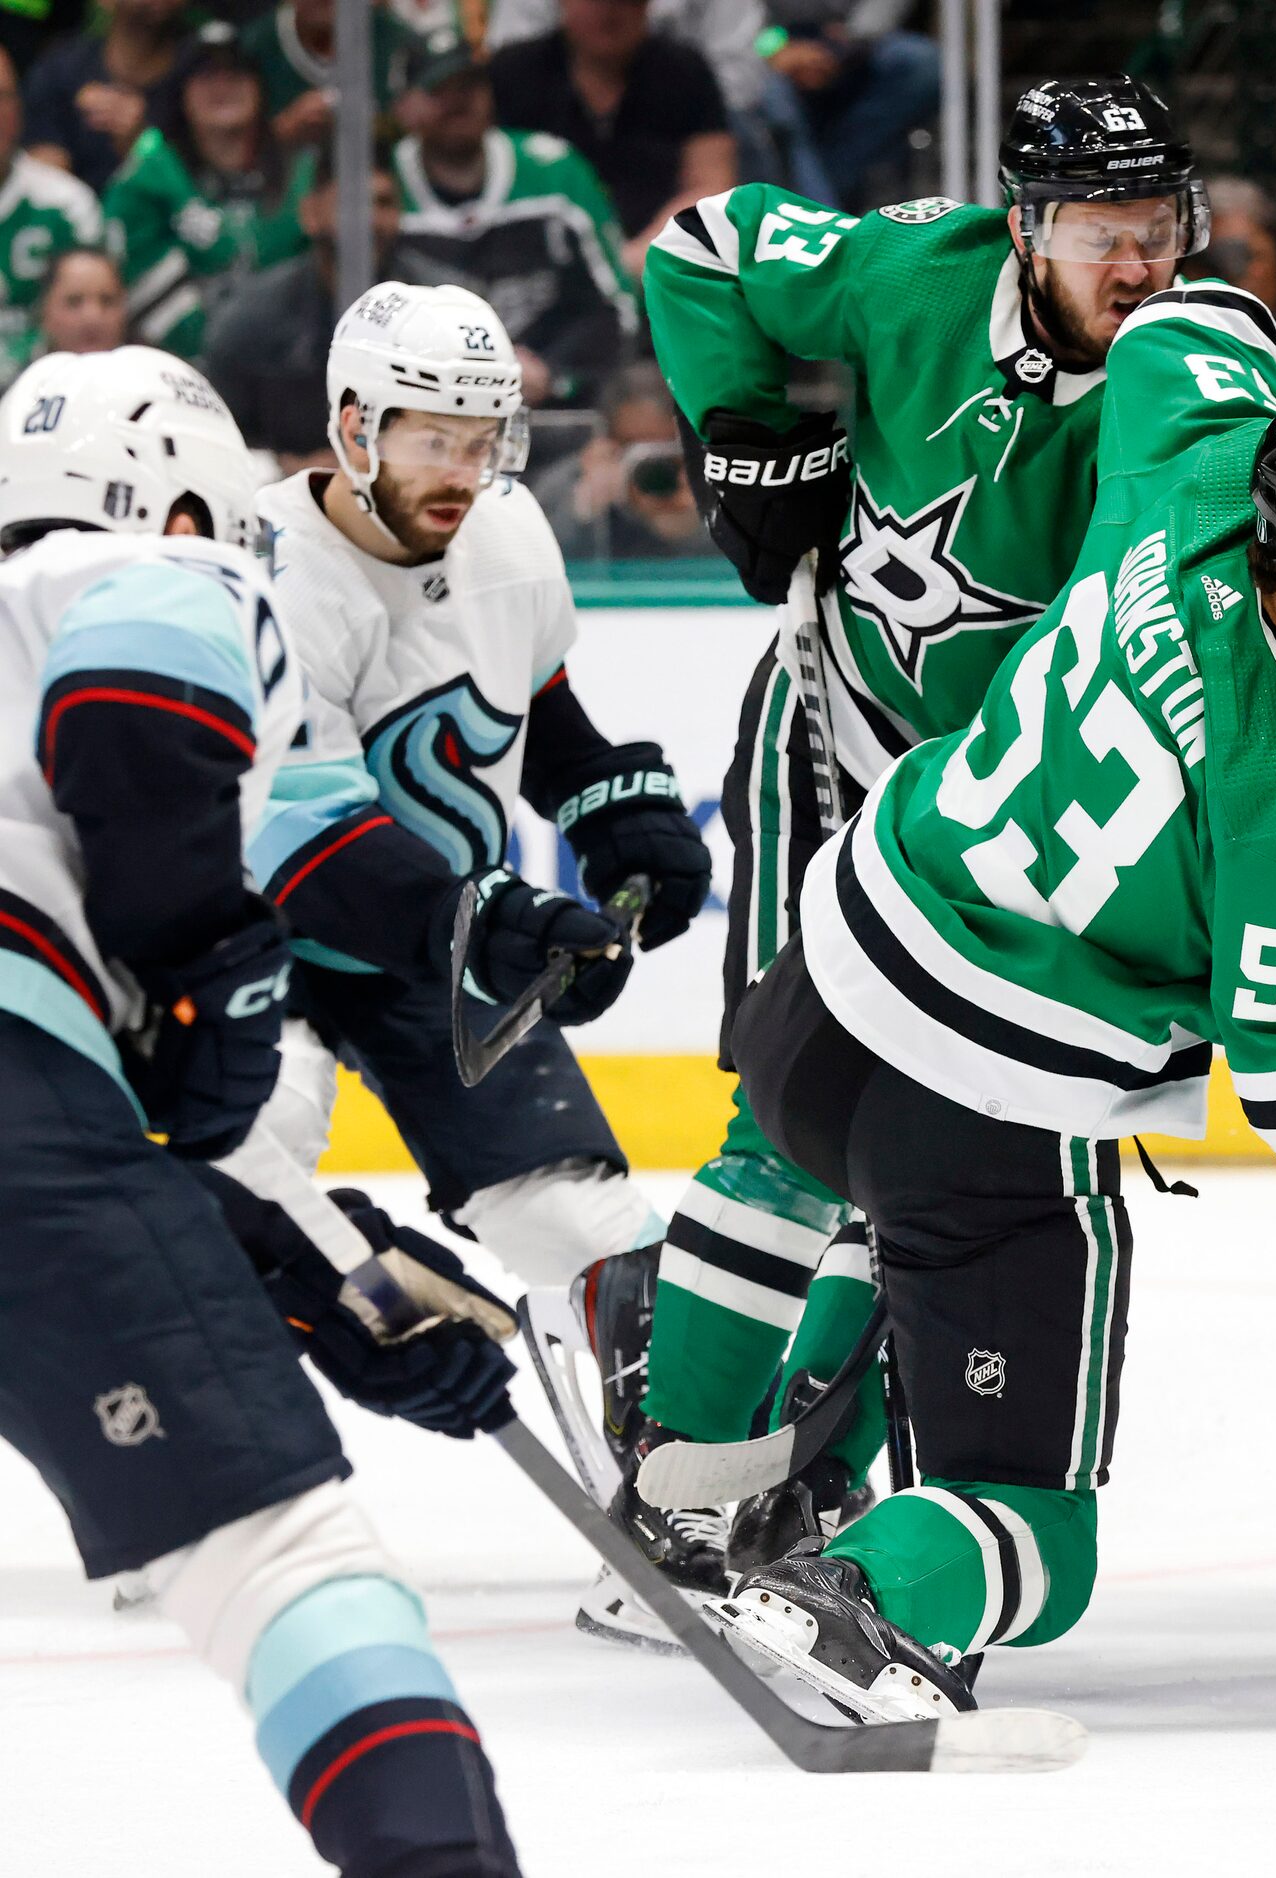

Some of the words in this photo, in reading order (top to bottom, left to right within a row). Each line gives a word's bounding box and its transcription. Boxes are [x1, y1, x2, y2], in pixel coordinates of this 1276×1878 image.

[1102, 107, 1147, 132] 63
[1106, 154, 1164, 170] BAUER
[459, 325, 494, 351] 22
[456, 375, 506, 386] CCM
[24, 396, 66, 434] 20
[703, 436, 850, 487] BAUER
[1201, 575, 1224, 621] adidas
[1113, 529, 1206, 769] JOHNSTON
[935, 571, 1187, 937] 53
[973, 1362, 998, 1384] NHL
